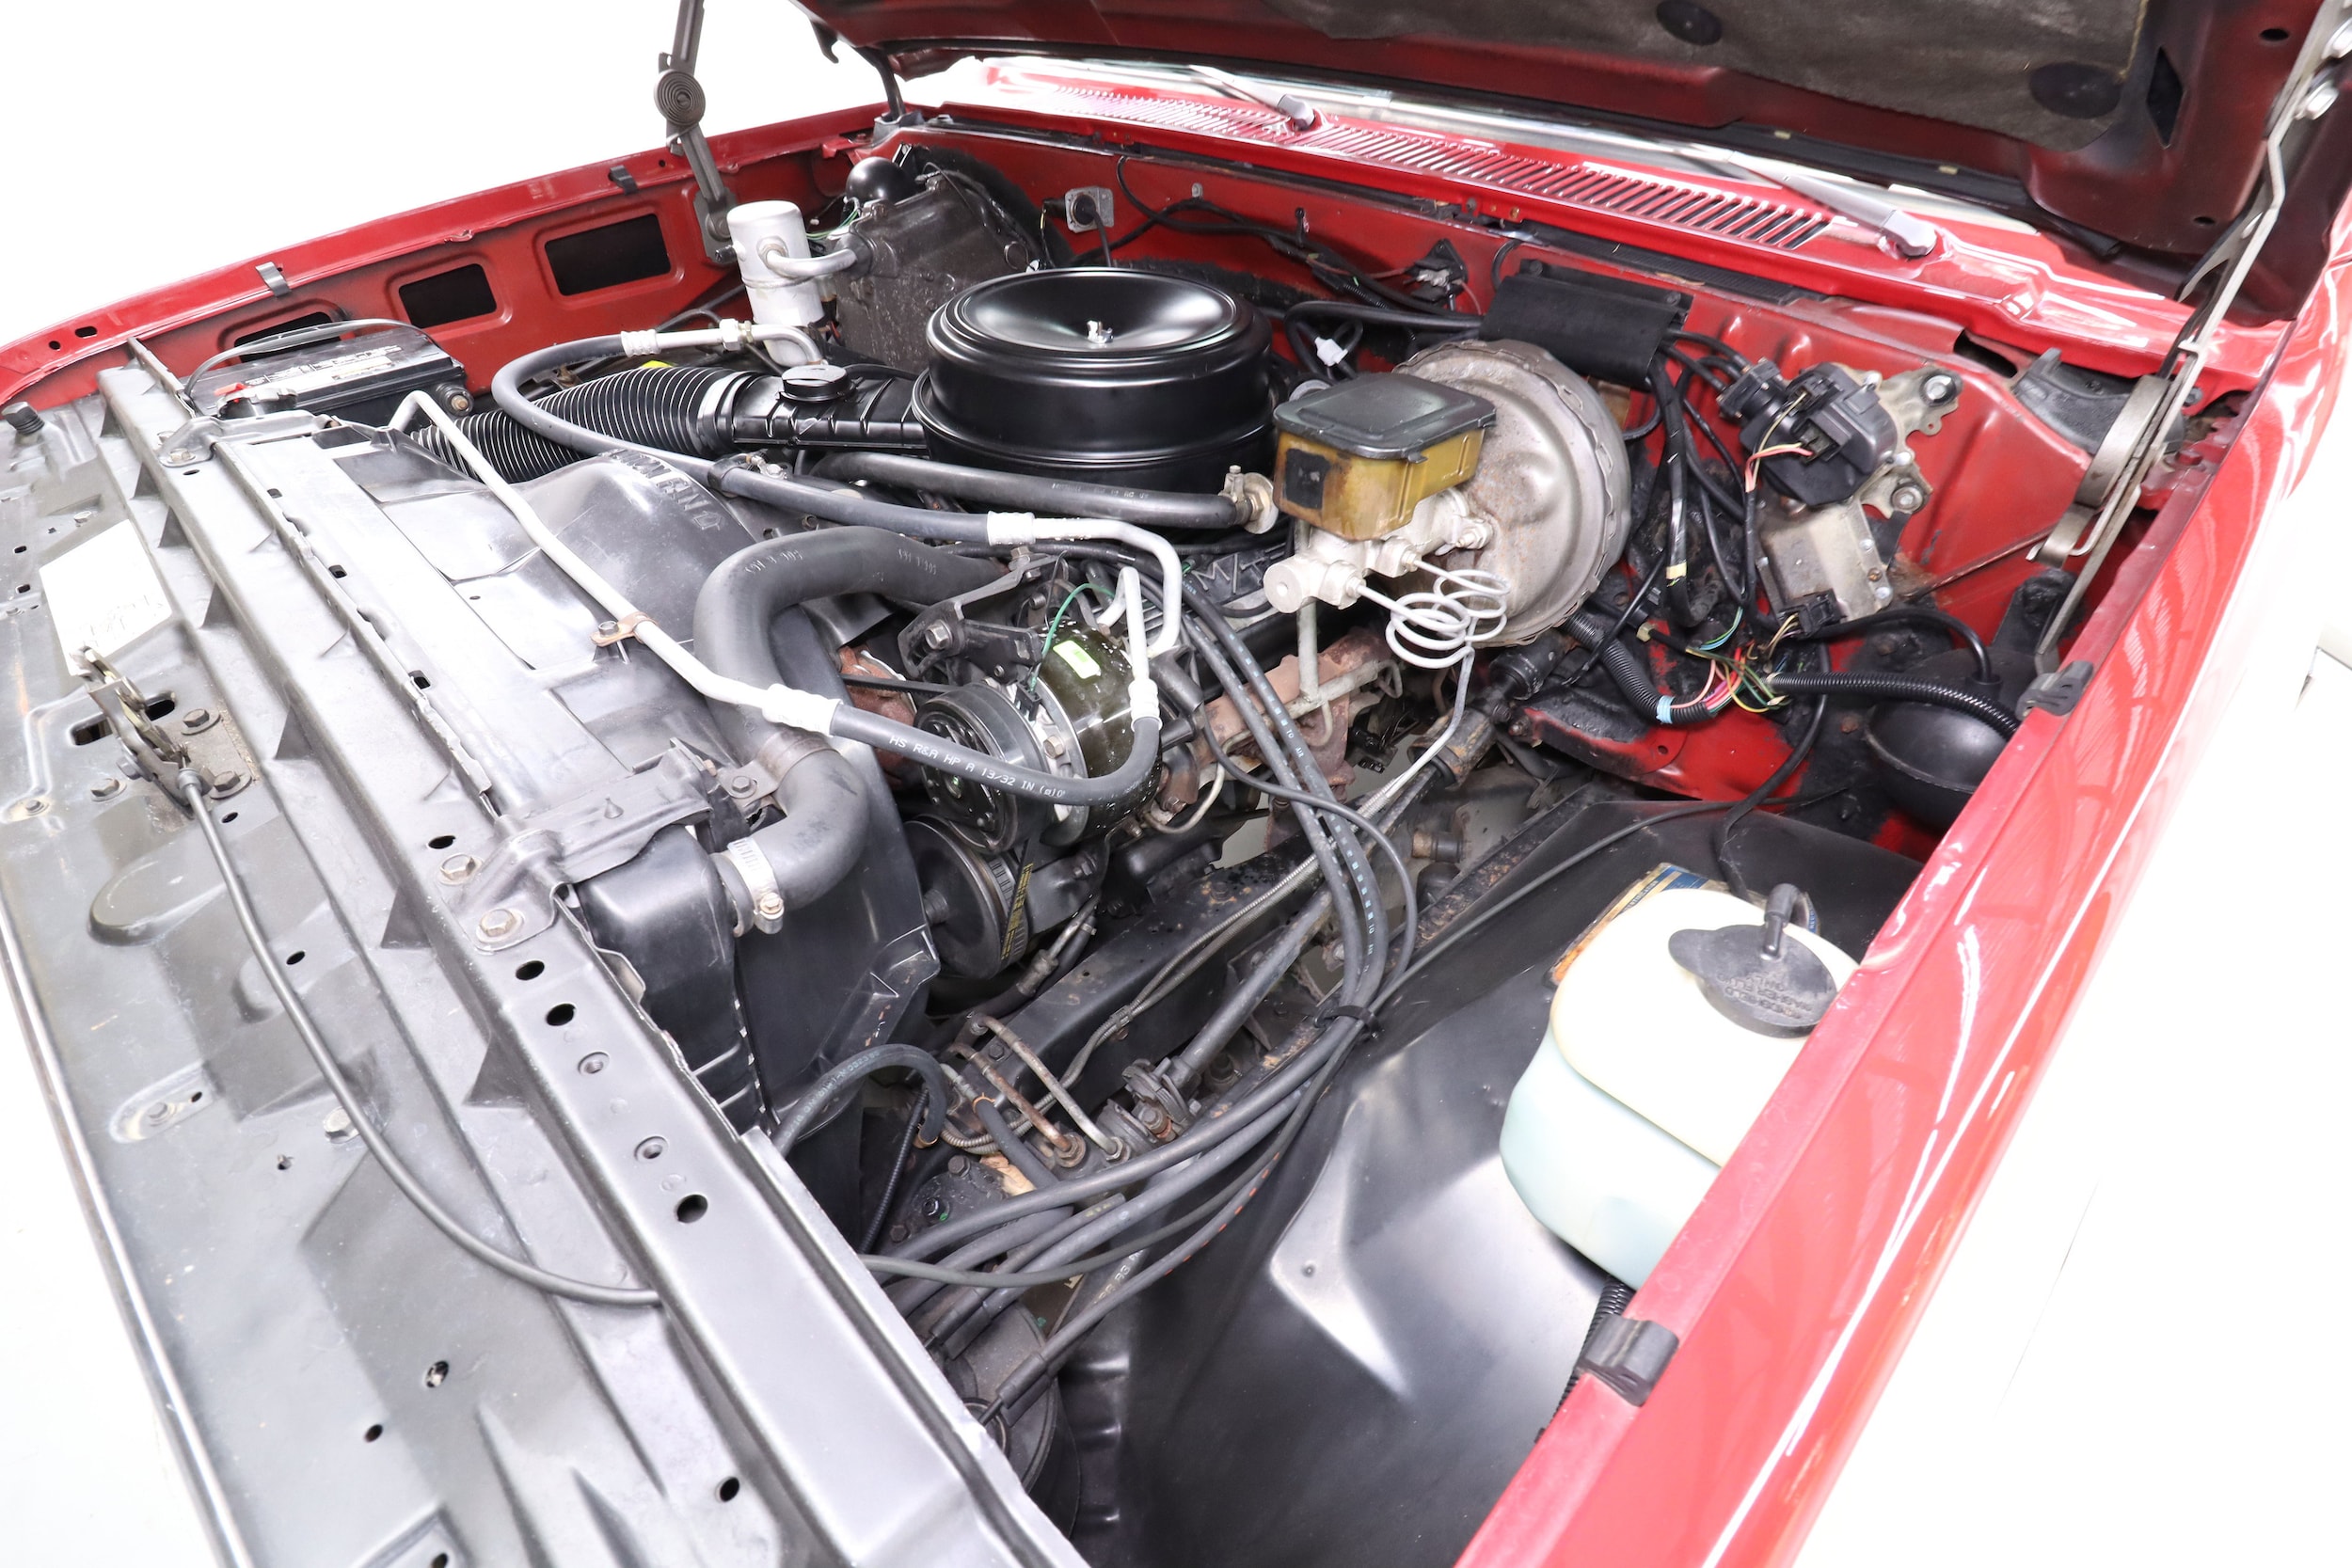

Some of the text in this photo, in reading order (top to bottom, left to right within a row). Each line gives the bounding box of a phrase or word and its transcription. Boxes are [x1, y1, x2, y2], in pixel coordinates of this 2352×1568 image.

[889, 736, 906, 749] HS
[913, 742, 939, 759] R&A
[944, 753, 961, 766] HP
[965, 763, 976, 773] A
[980, 768, 1016, 786] 13/32
[1021, 781, 1035, 793] IN
